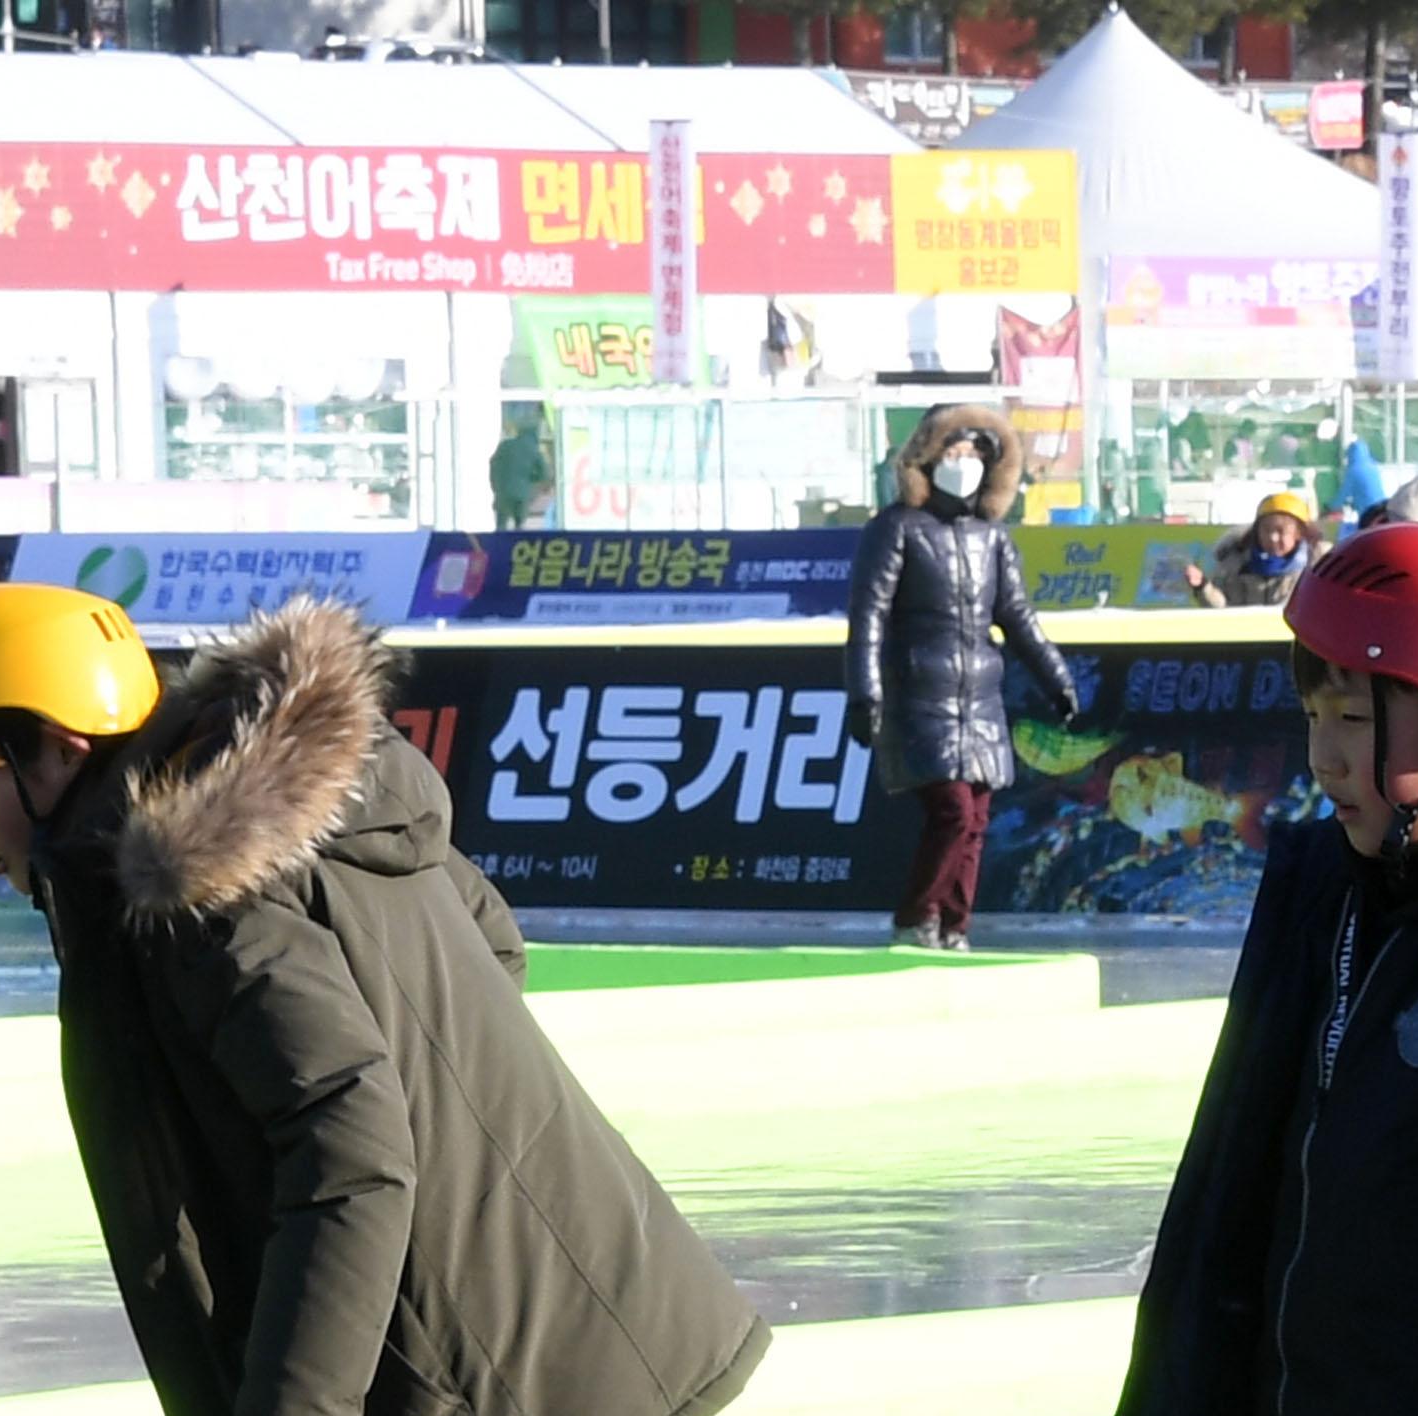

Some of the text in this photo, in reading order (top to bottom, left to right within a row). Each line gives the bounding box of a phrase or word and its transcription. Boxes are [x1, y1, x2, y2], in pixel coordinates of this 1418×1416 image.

[178, 153, 705, 246] 산천어축제 면세
[914, 218, 1062, 251] 평창동계올림픽
[325, 252, 366, 281] Tax
[369, 253, 418, 282] Free
[422, 252, 476, 283] Shop
[958, 256, 1020, 288] 홍보관
[509, 539, 628, 588] 얼음나라
[636, 539, 728, 589] 방송국
[762, 560, 805, 582] MBC
[486, 685, 867, 827] 선등거리
[503, 854, 533, 881] 6시
[560, 854, 599, 881] 10시
